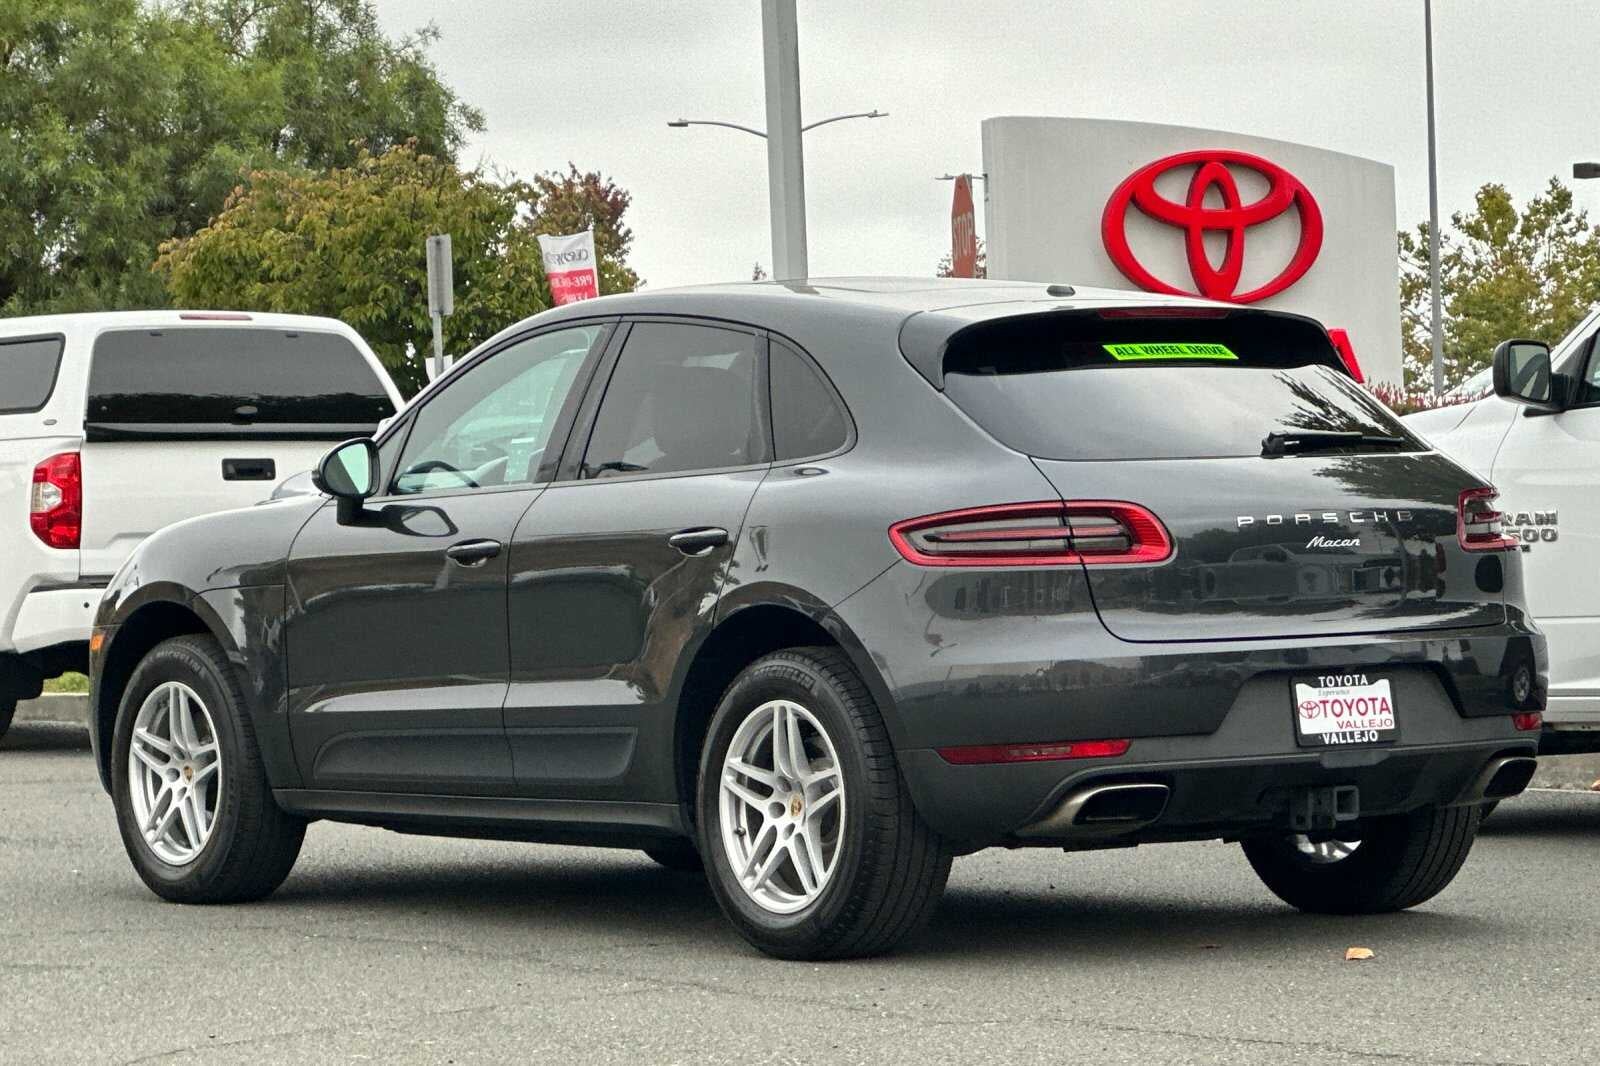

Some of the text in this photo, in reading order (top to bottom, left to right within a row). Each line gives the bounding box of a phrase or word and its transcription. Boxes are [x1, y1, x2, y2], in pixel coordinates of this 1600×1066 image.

[952, 211, 974, 260] STOP
[1113, 345, 1227, 356] ALL WHEEL DRIVE
[1237, 510, 1413, 527] PORSCHE
[1306, 535, 1360, 549] Macan
[1318, 674, 1369, 688] TOYOTA
[1319, 697, 1392, 718] TOYOTA
[1336, 718, 1393, 729] VALLEJO
[1322, 730, 1378, 744] VALLEJO
